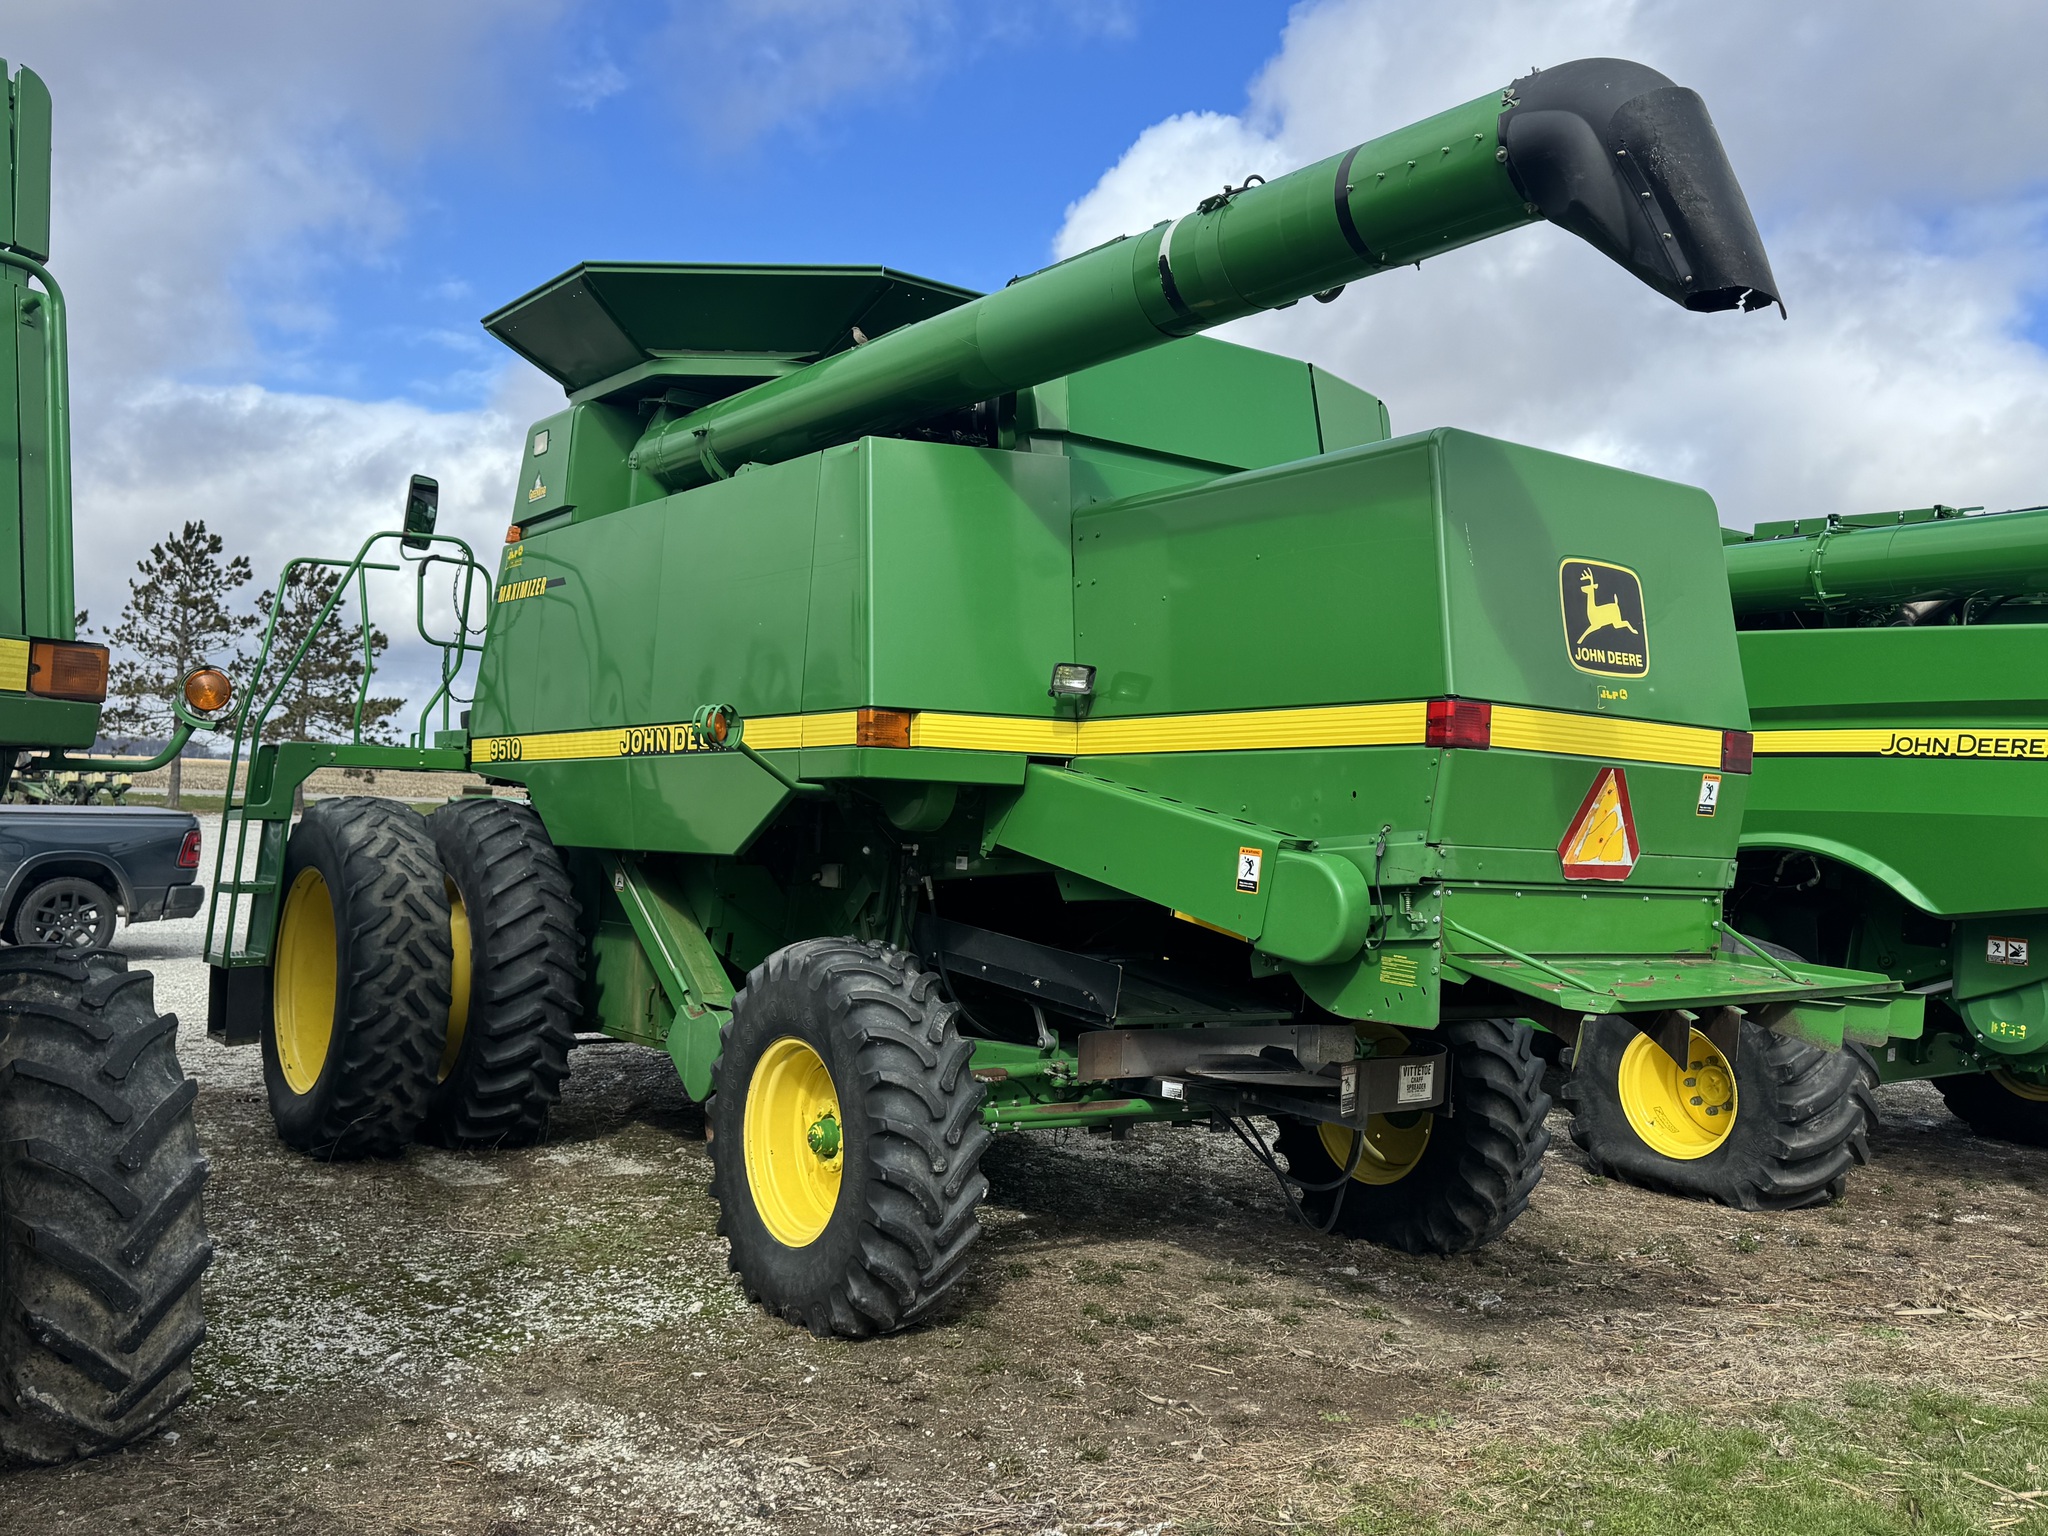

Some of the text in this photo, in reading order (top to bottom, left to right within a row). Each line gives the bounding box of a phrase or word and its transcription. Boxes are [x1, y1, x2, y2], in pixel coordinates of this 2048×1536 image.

[498, 576, 547, 603] MAXIMIZER
[1575, 647, 1643, 668] JOHN DEERE
[490, 738, 522, 761] 9510
[620, 727, 668, 755] JOHN
[1881, 733, 2046, 756] JOHN DEERE
[1403, 1065, 1431, 1077] VITTETOE
